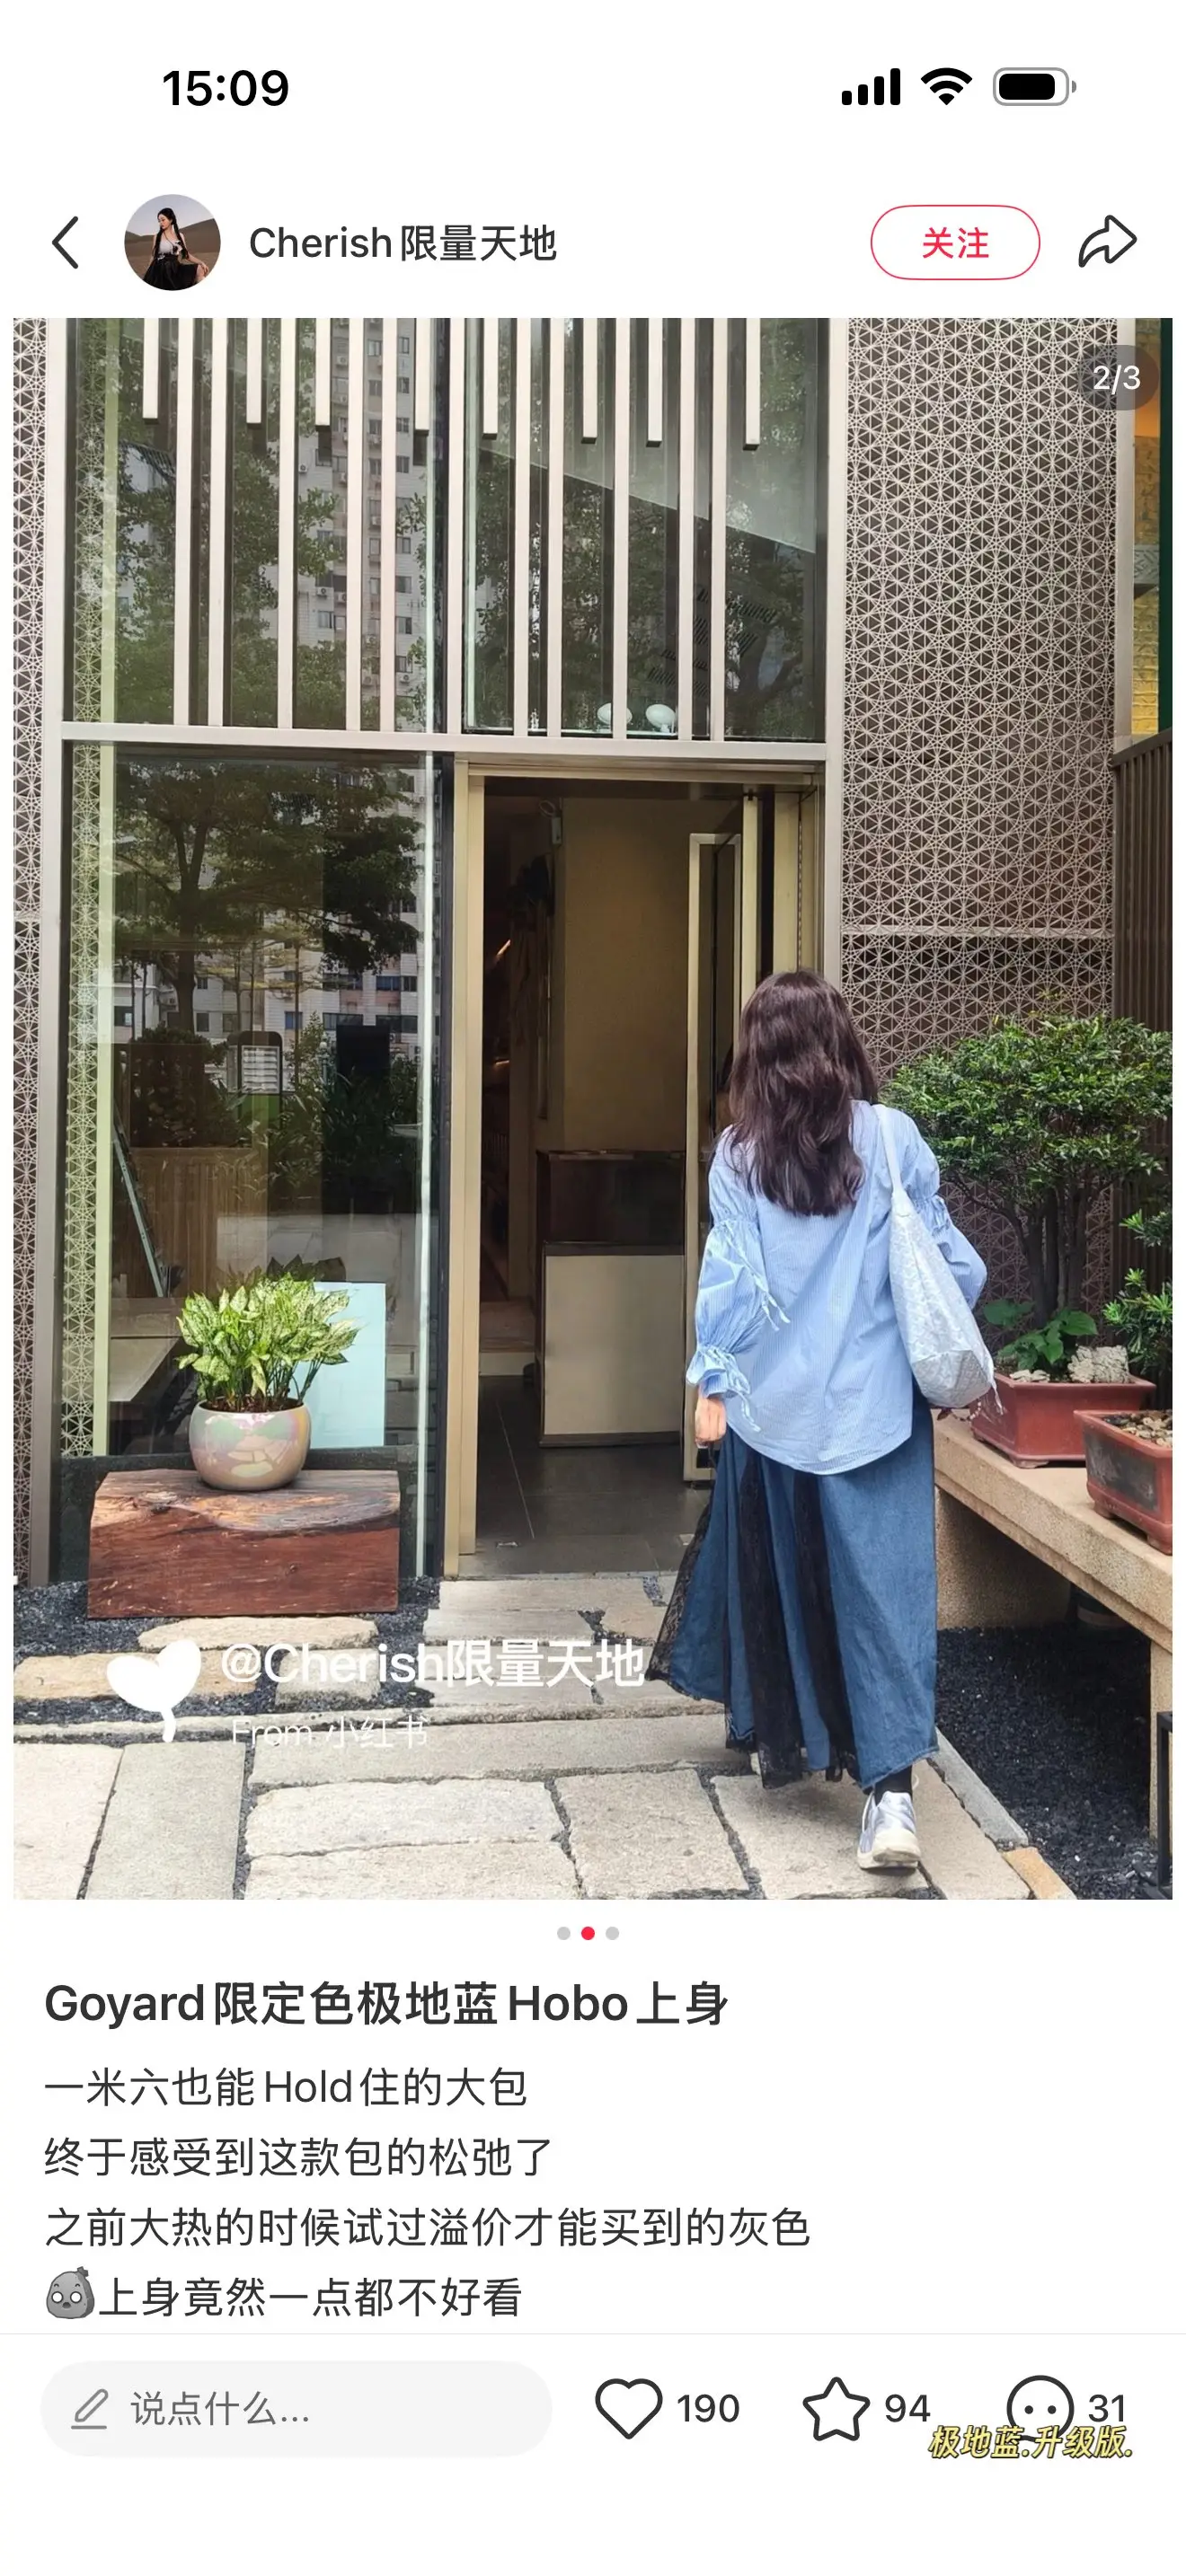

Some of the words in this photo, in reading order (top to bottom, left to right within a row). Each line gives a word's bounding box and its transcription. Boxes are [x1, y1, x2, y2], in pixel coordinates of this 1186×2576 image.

[163, 69, 289, 107] 15:09
[250, 224, 557, 262] Cherish限量天地
[922, 226, 990, 260] 关注
[44, 2136, 551, 2177] 终于感受到这款包的松弛了
[45, 2206, 810, 2247] 之前大热的时候试过溢价才能买到的灰色
[98, 2276, 522, 2317] 上身竟然一点都不好看
[677, 2393, 740, 2423] 190
[884, 2393, 932, 2423] 94
[1088, 2393, 1124, 2423] 31
